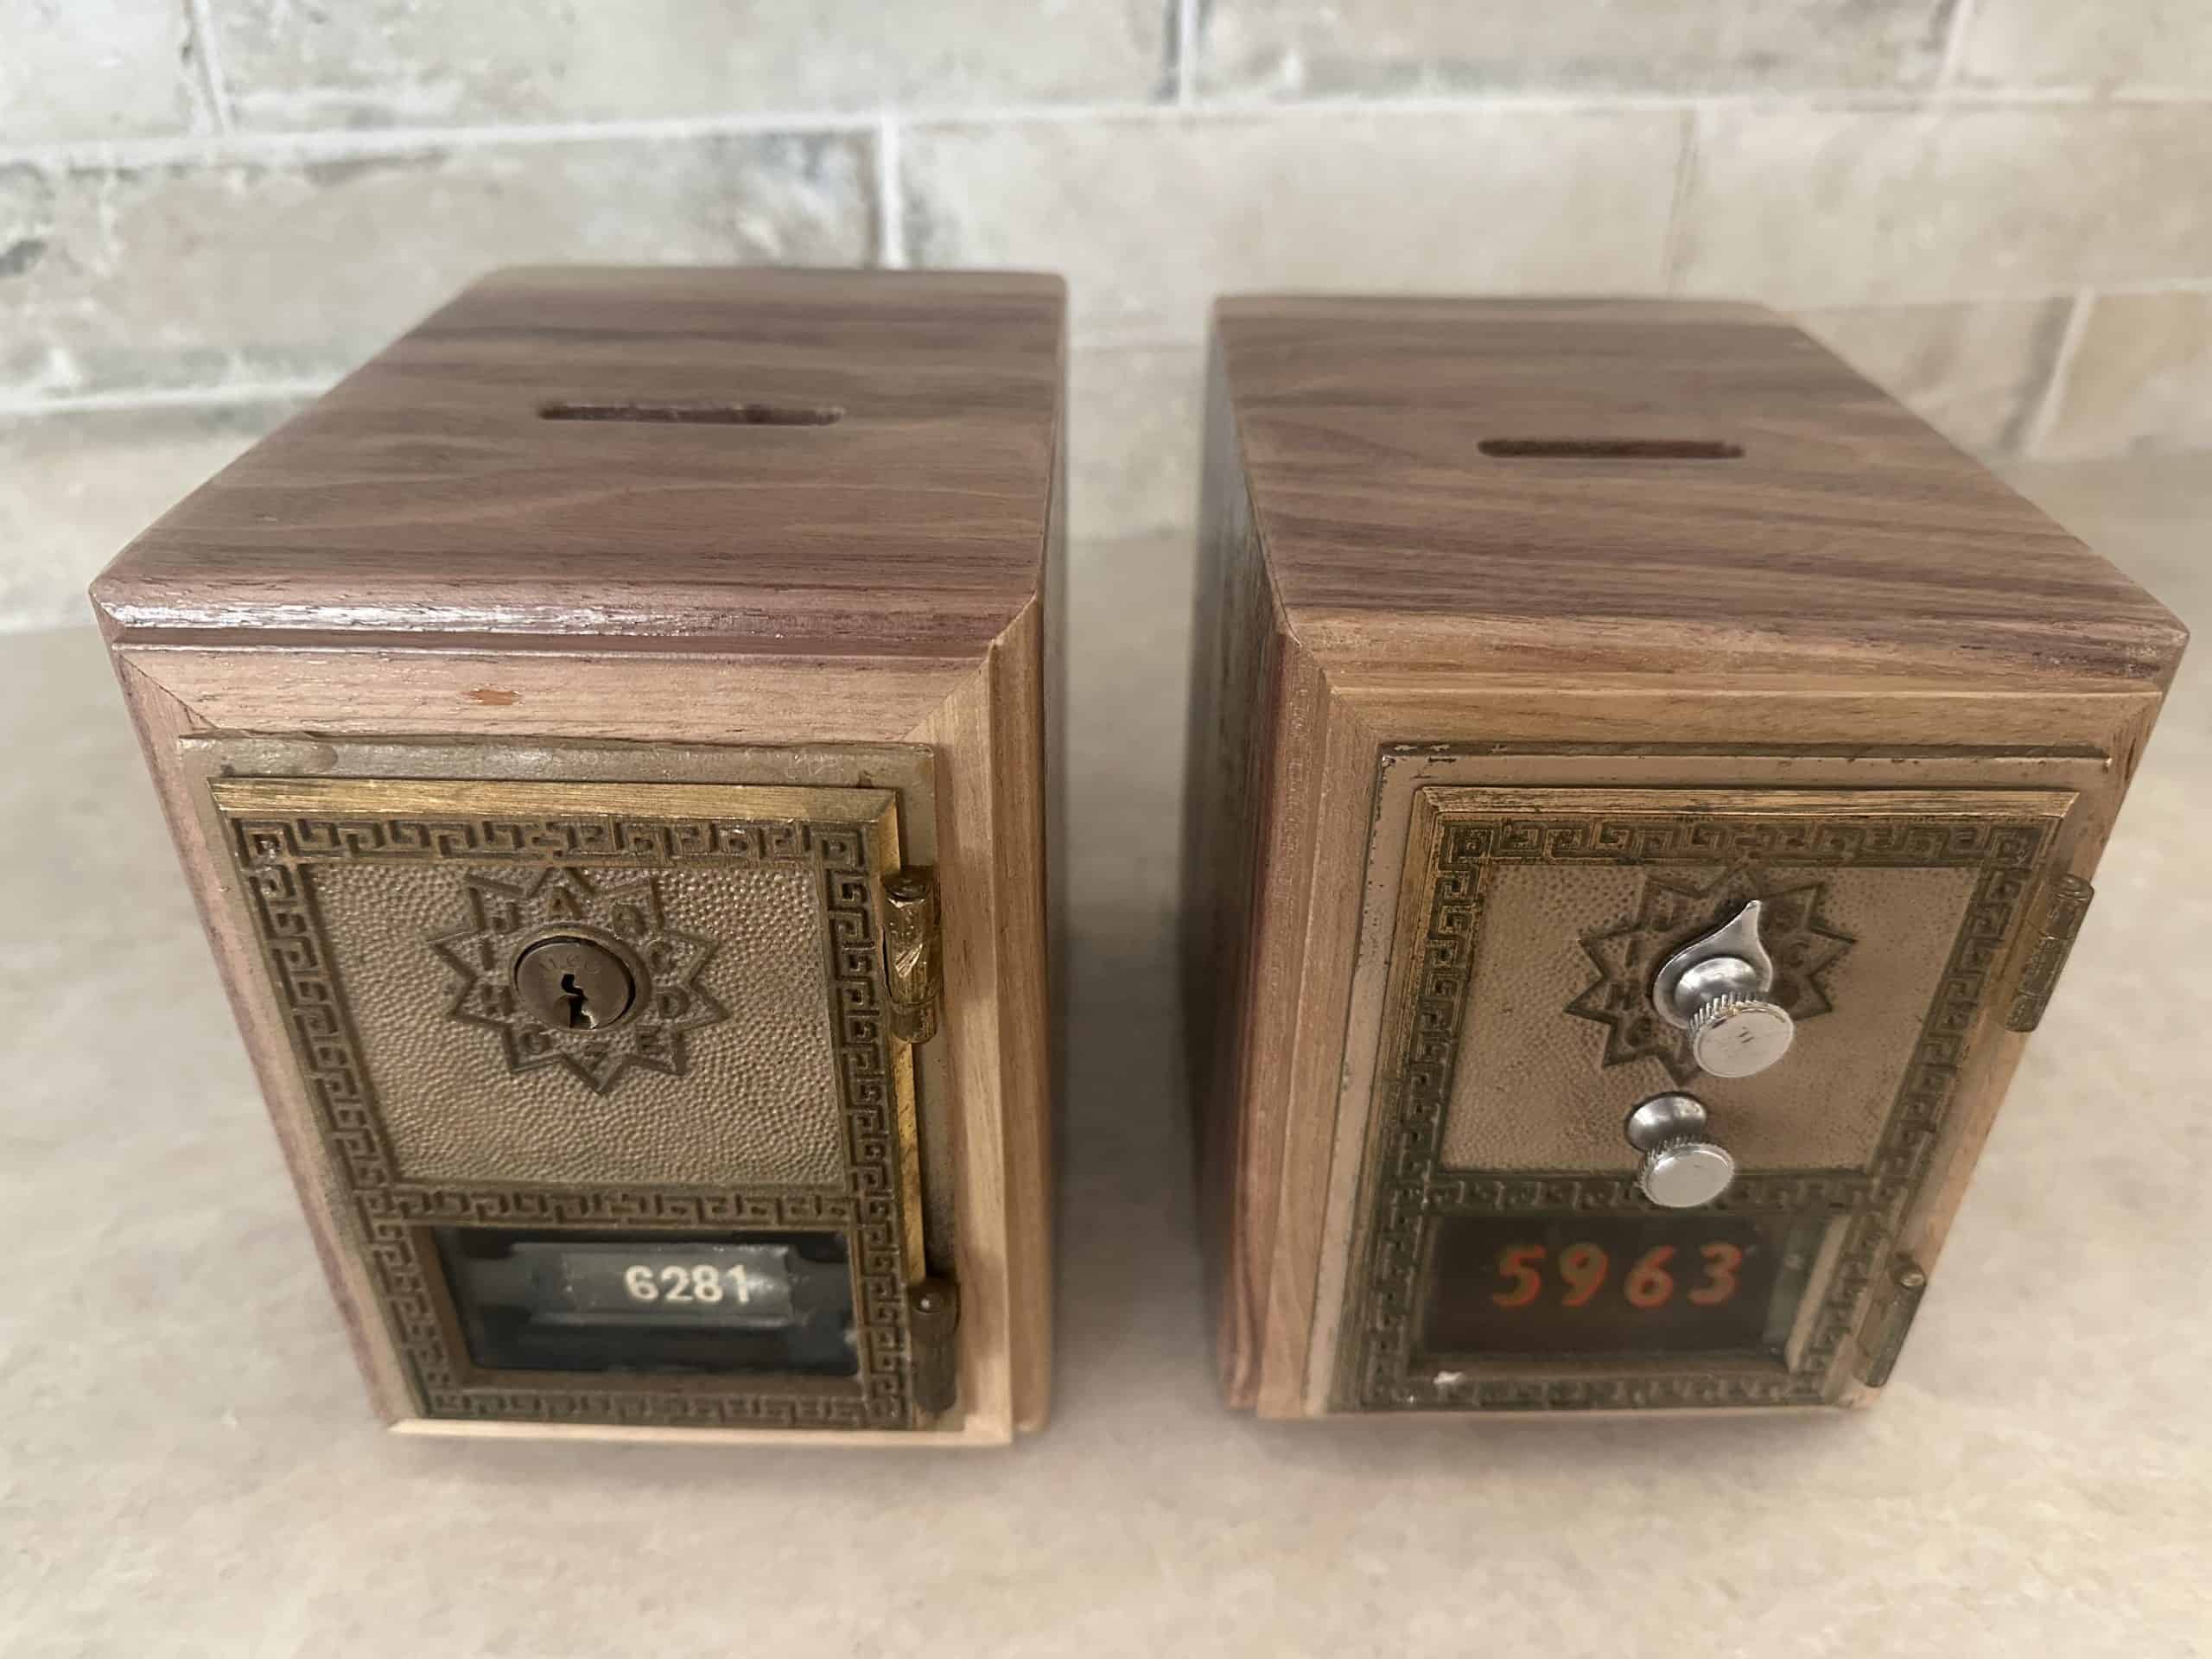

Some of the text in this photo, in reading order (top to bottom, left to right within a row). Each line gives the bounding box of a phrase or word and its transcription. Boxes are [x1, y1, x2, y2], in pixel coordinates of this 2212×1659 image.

[546, 887, 581, 920] A
[659, 988, 691, 1019] D
[624, 1263, 749, 1303] 6281
[1492, 1243, 1743, 1307] 5963
